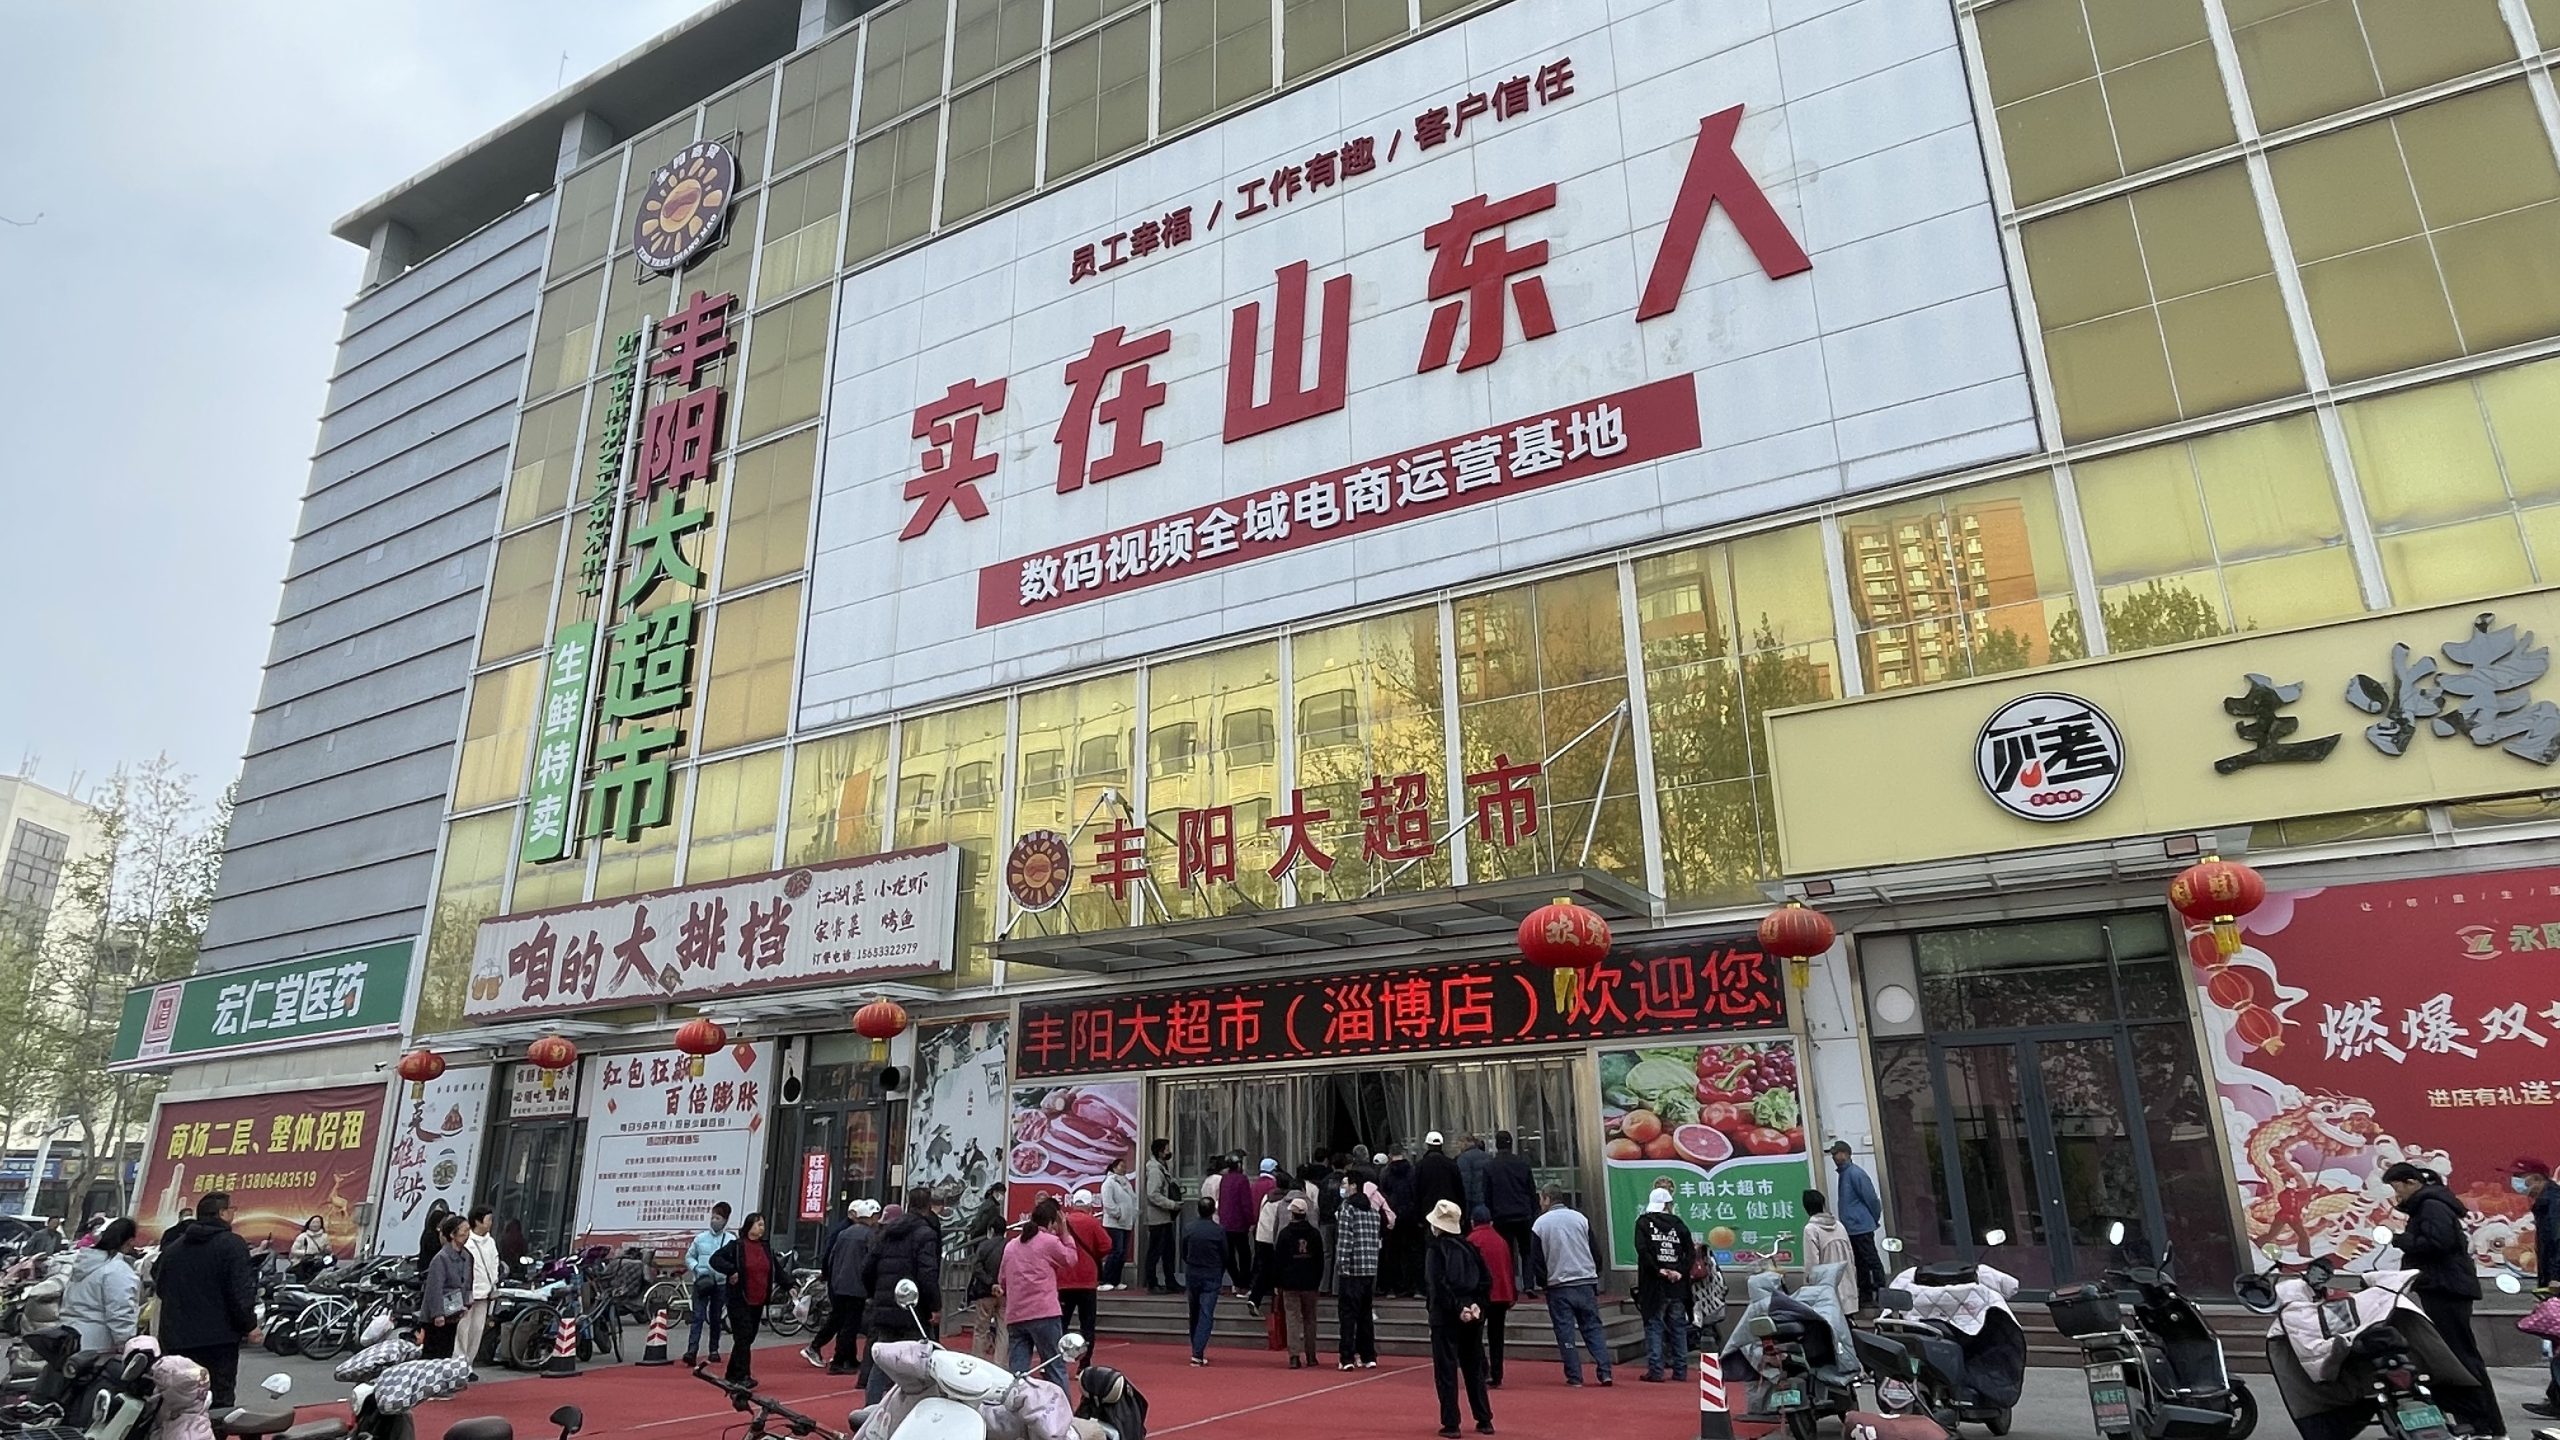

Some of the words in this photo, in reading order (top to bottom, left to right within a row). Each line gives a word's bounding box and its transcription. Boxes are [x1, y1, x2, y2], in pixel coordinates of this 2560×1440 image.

[1069, 205, 1193, 284] 员工幸福
[1235, 136, 1376, 220] 工作有趣
[1413, 57, 1576, 150] 客户信任
[899, 103, 1813, 541] 实在山东人
[577, 330, 635, 597] SUPERMARKET
[1018, 404, 1629, 606] 数码视频全域电商运营基地
[588, 289, 731, 841] 丰阳大超市
[528, 639, 586, 844] 生鲜特卖
[1090, 755, 1543, 901] 丰阳大超市
[814, 913, 861, 943] 家常菜
[881, 908, 915, 933] 烤鱼
[816, 879, 866, 909] 江湖菜
[874, 871, 929, 897] 小龙虾
[508, 896, 793, 1002] 咱的大排档
[211, 961, 368, 1035] 宏仁堂医药
[665, 1080, 760, 1116] 百倍膨胀
[2427, 1080, 2560, 1108] 进店有礼送
[167, 1109, 365, 1160] 商场二层、整体招租
[806, 1154, 826, 1213] 旺铺招商
[1680, 1179, 1774, 1198] 丰阳大超市
[1690, 1201, 1737, 1221] 绿色
[1746, 1200, 1796, 1220] 健康
